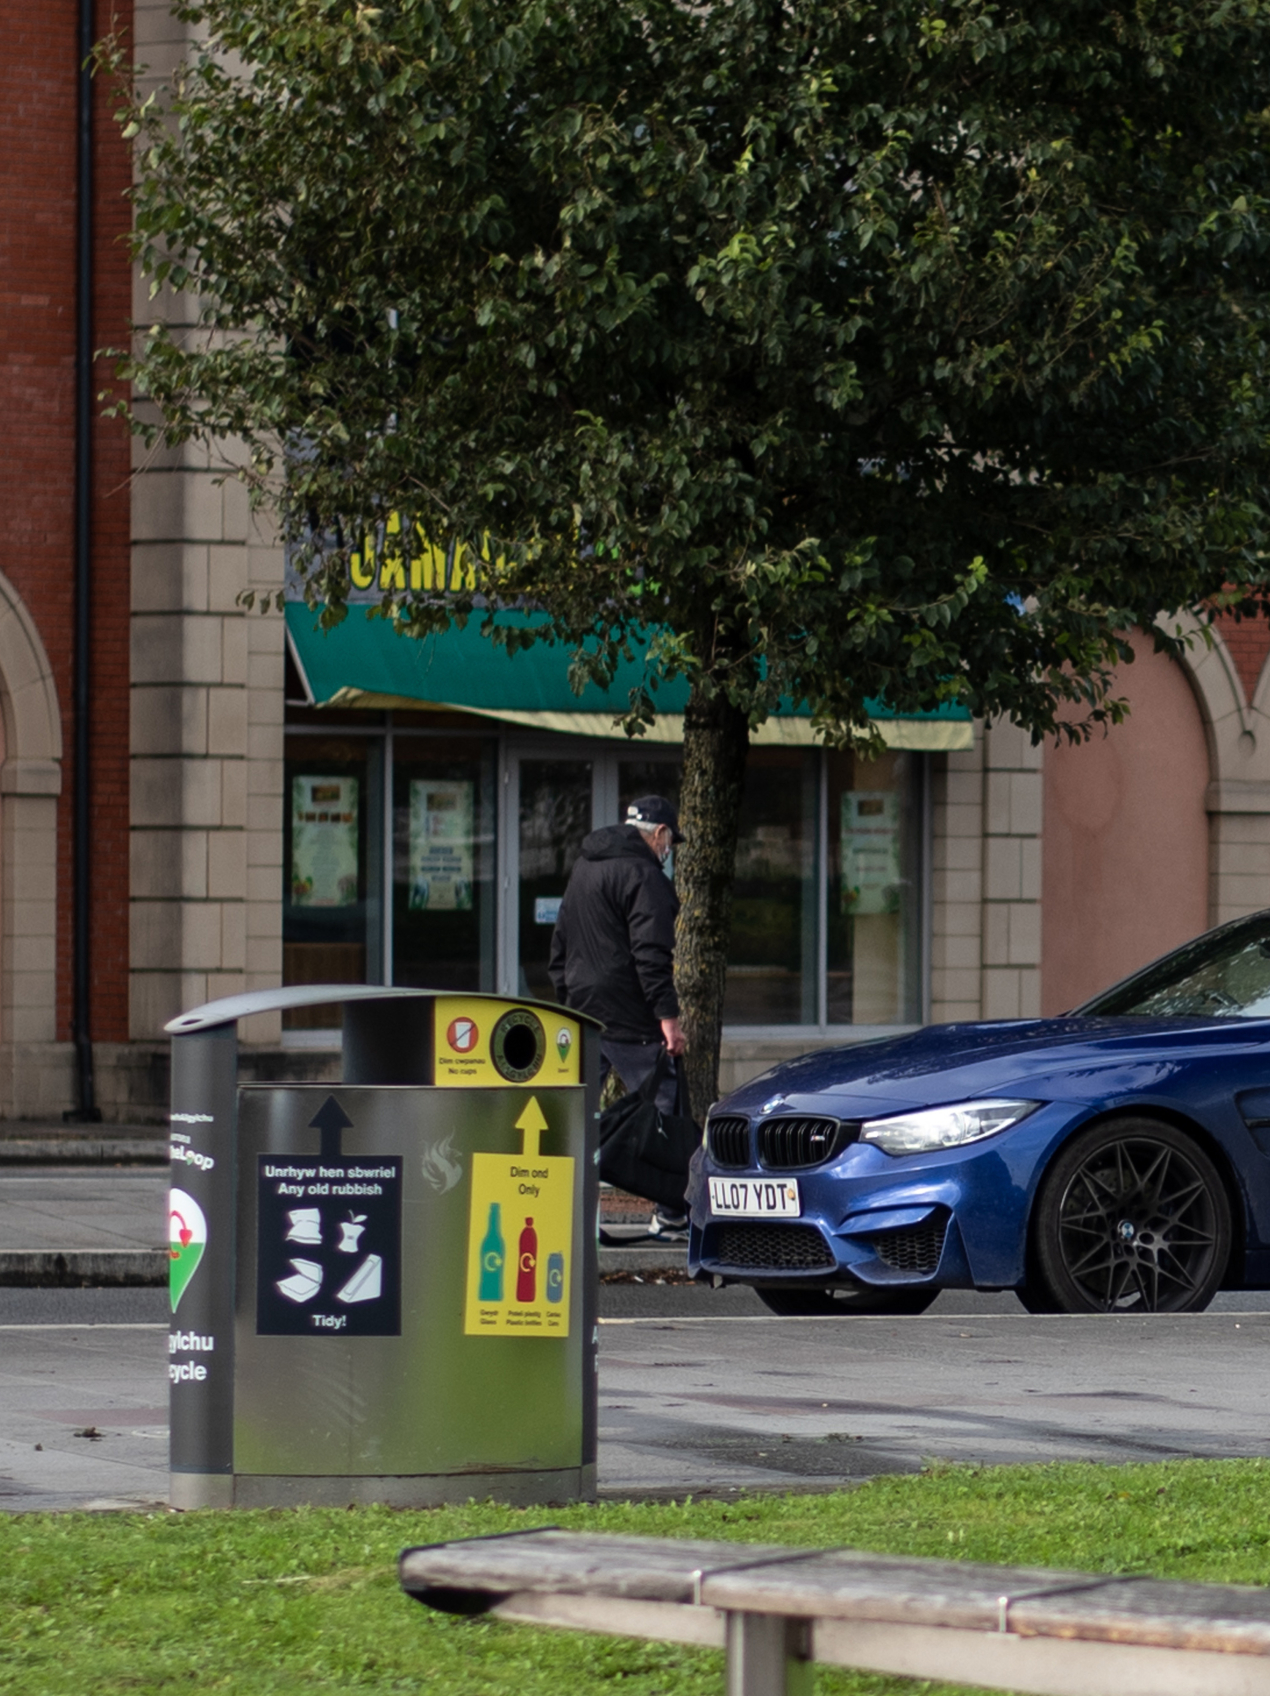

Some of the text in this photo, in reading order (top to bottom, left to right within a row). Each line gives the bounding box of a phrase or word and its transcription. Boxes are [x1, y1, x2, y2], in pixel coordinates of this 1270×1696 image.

[264, 1165, 396, 1180] Unrhyw hen sbwriel
[510, 1166, 549, 1178] Dim ond
[277, 1182, 383, 1197] Any old rubbish
[518, 1183, 540, 1198] Only
[713, 1182, 788, 1211] LL07 YDT
[311, 1314, 347, 1330] Tidy!
